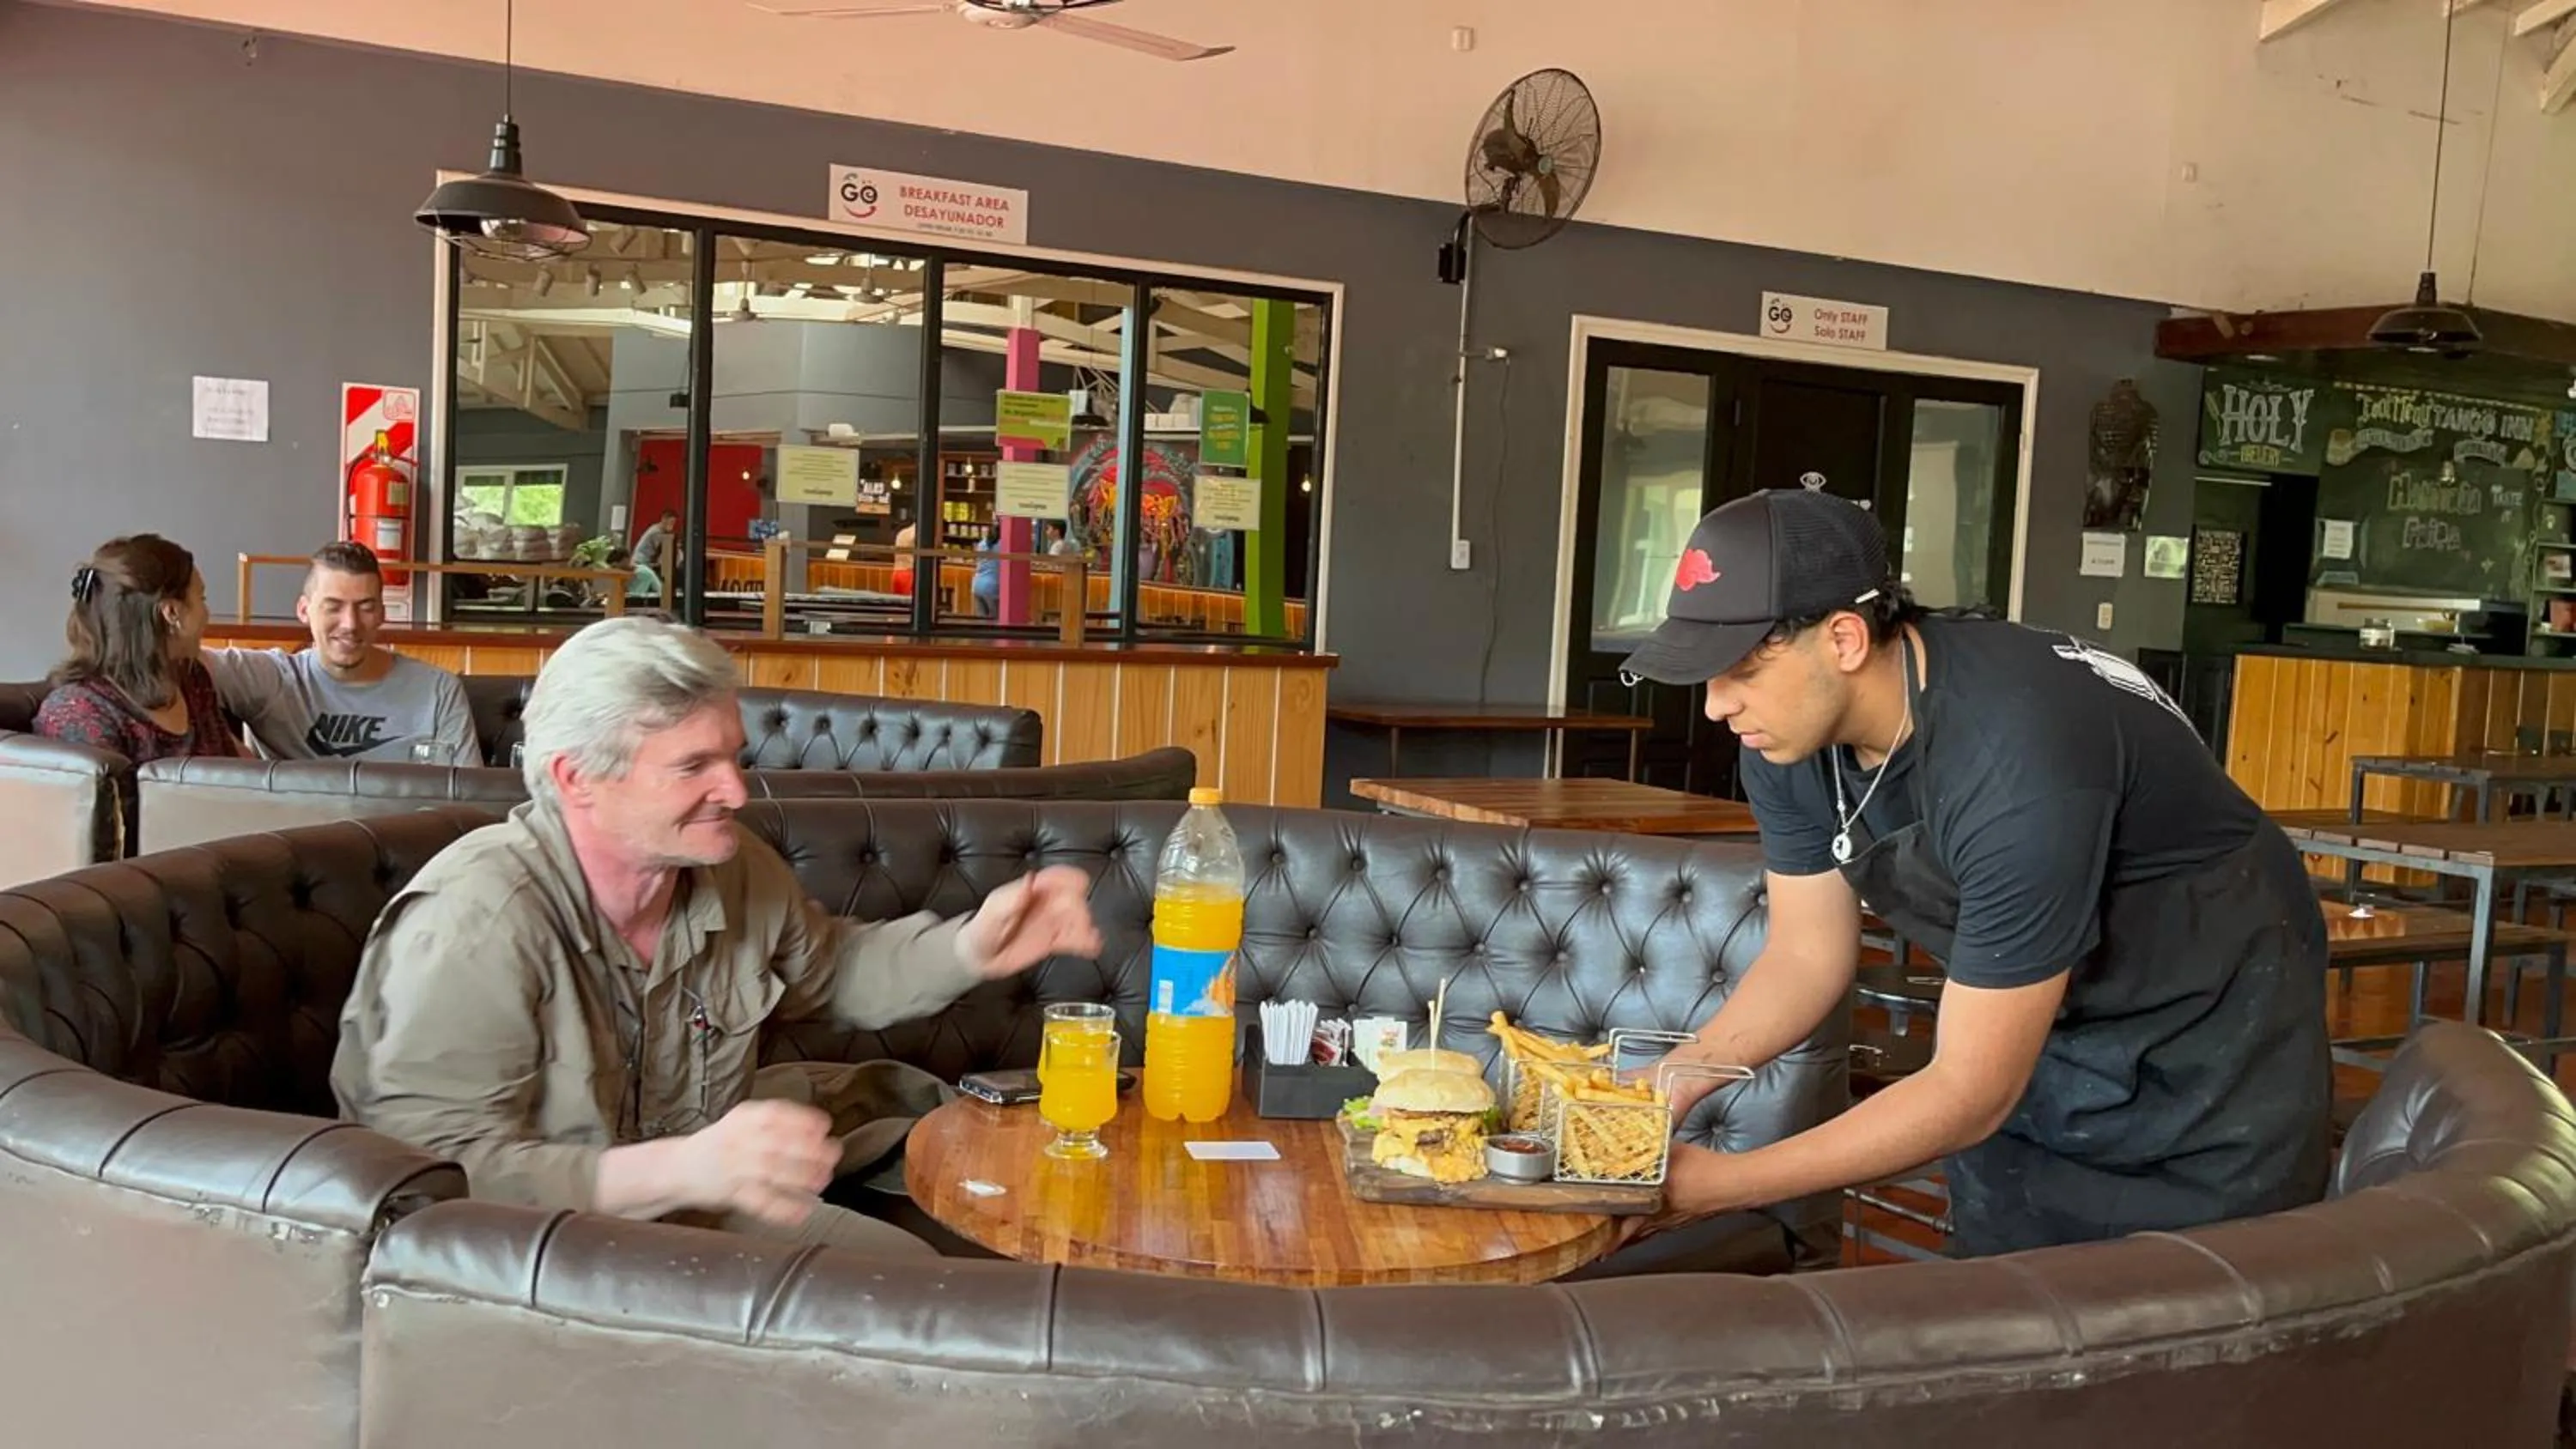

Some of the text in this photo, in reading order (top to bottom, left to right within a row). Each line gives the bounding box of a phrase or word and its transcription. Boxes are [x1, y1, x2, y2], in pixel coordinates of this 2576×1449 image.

[899, 185, 1010, 211] BREAKFAST AREA
[904, 204, 1004, 228] DESAYUNADOR
[1814, 308, 1868, 325] Only STAFF
[1814, 325, 1867, 341] Solo STAFF
[2219, 385, 2315, 454] HOLY
[2433, 404, 2496, 435] TANGO
[2500, 414, 2534, 442] INN
[311, 712, 387, 743] NIKE
